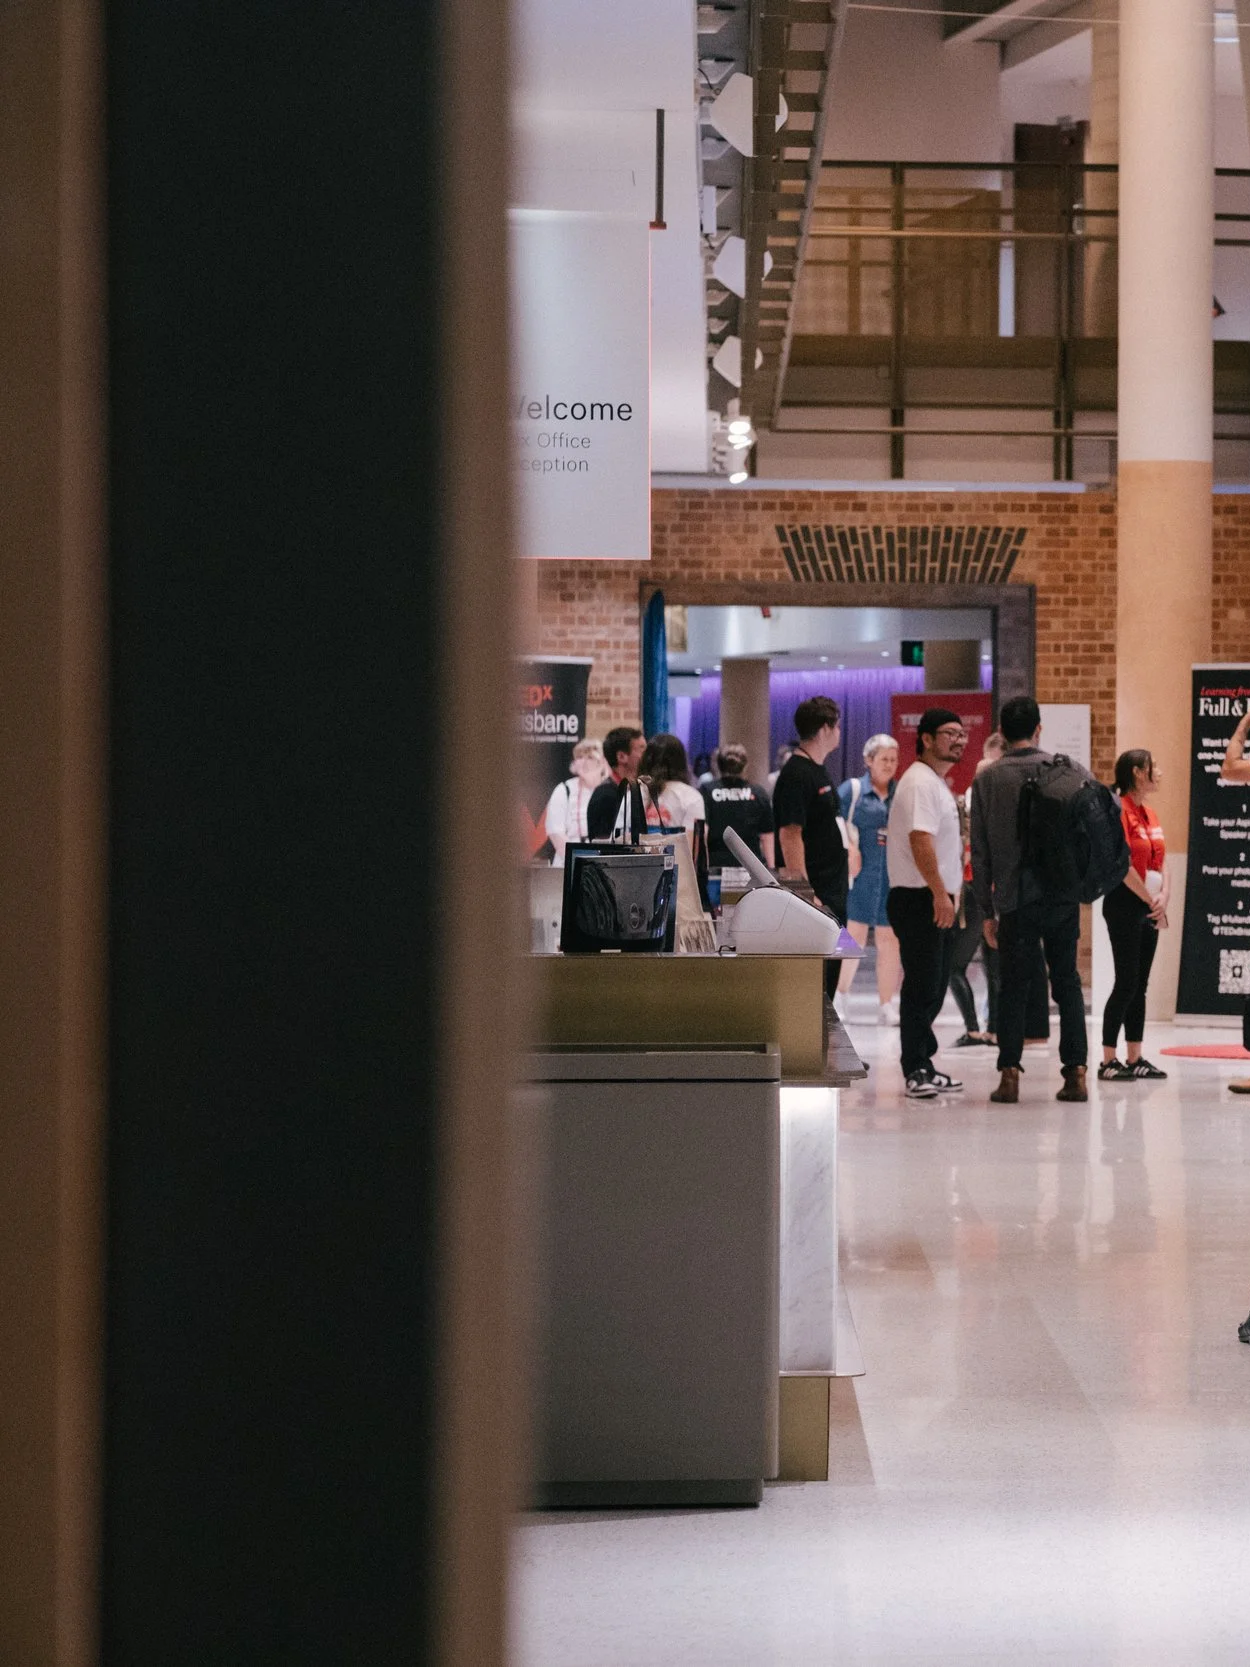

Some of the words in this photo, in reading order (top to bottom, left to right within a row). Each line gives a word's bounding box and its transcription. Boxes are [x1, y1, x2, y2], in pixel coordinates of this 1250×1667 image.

[517, 394, 633, 421] elcome
[537, 432, 591, 448] Office
[519, 456, 589, 474] ception
[1200, 686, 1236, 698] Learning
[1198, 697, 1230, 716] Full
[1231, 700, 1243, 717] &
